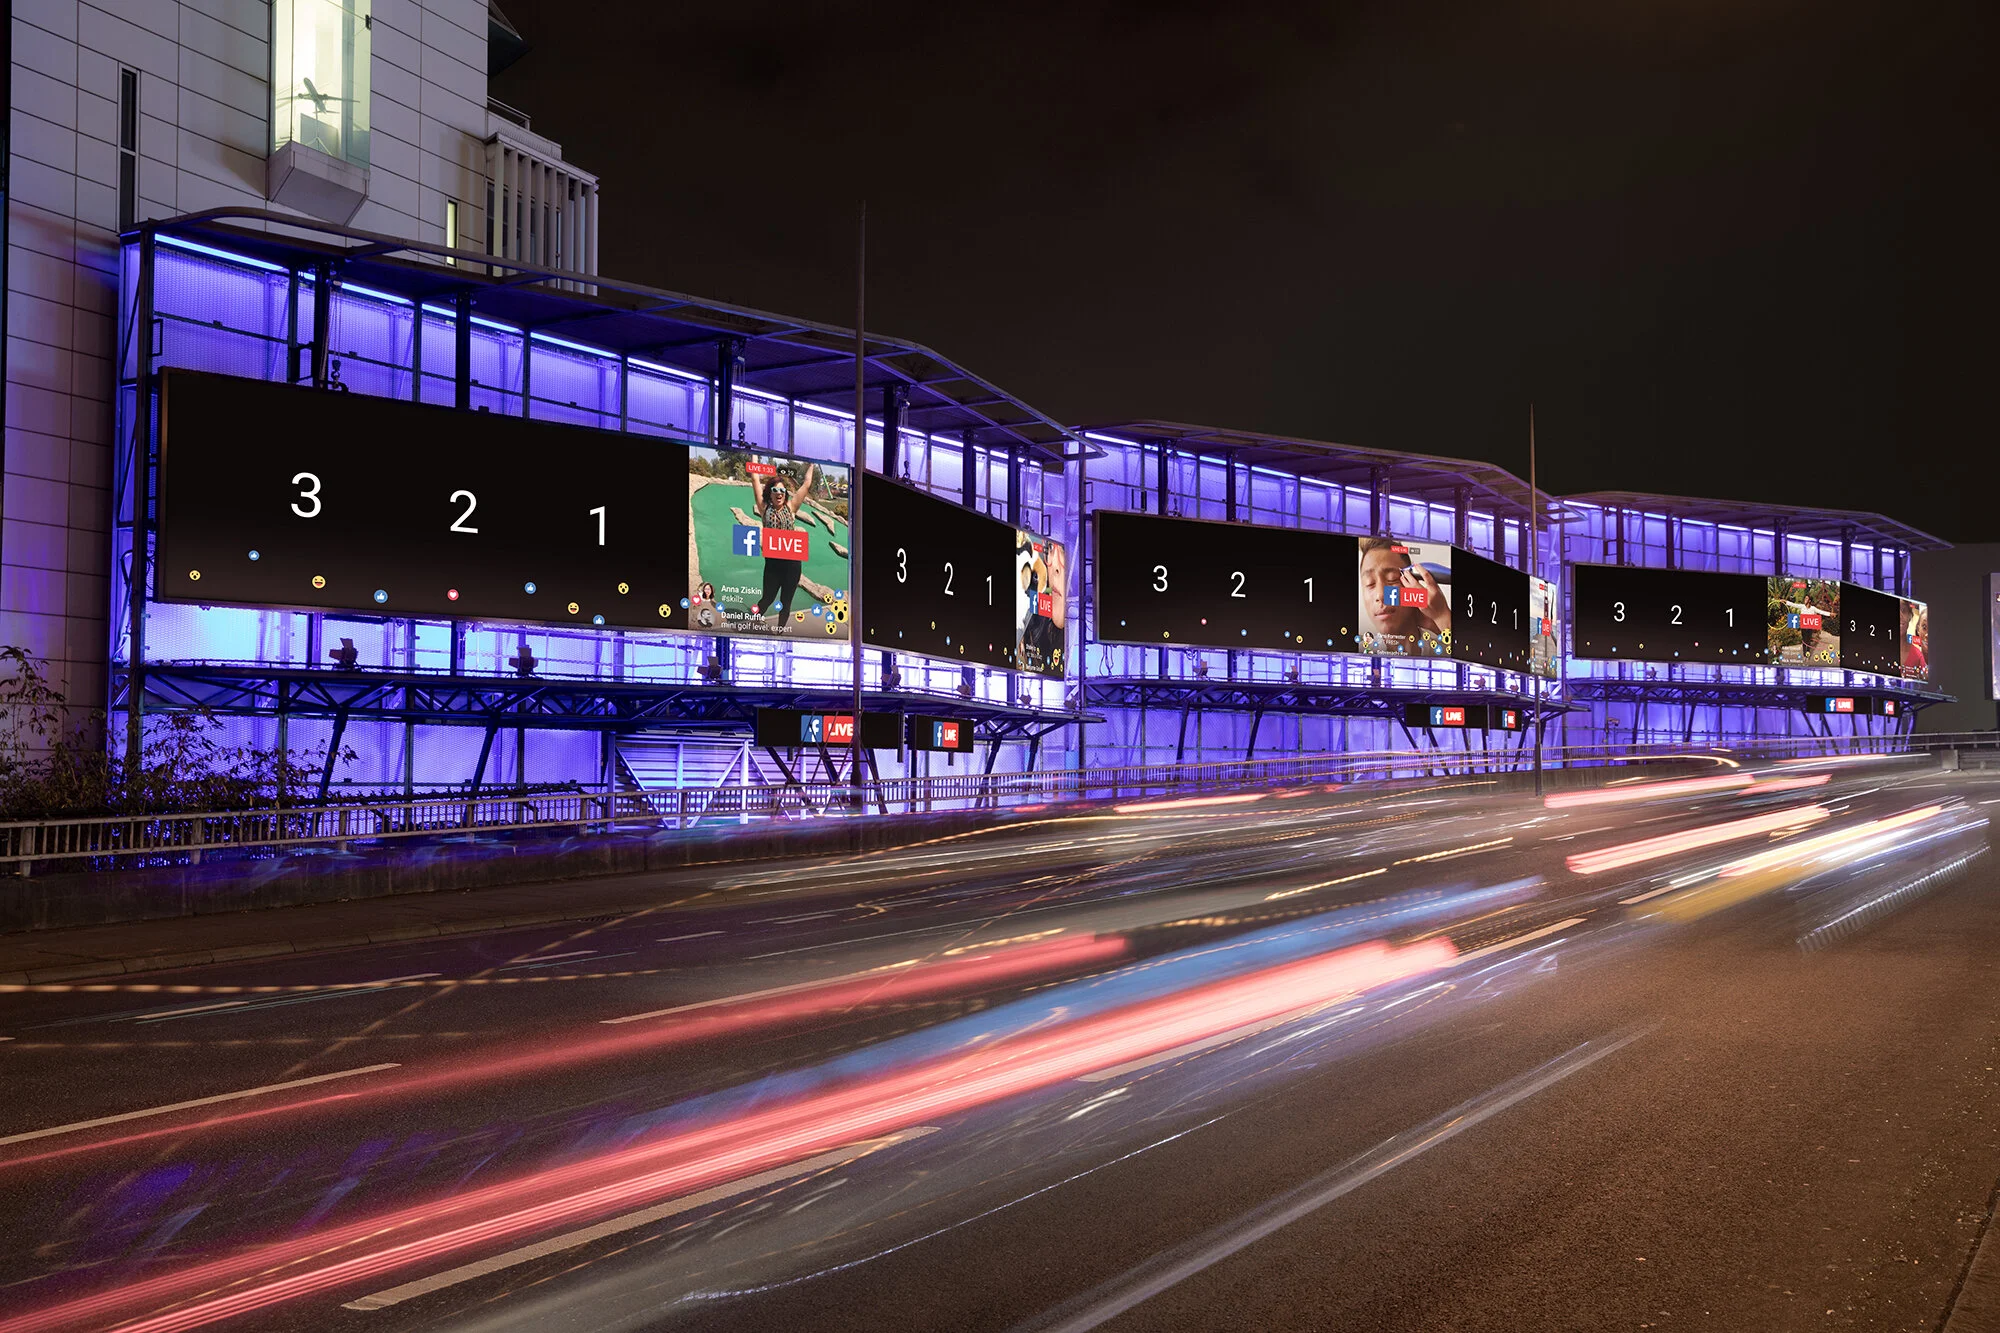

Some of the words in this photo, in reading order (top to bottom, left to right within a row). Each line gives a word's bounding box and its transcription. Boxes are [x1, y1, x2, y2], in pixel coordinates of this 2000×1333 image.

[748, 464, 761, 472] LIVE
[290, 472, 322, 518] 3
[449, 489, 479, 534] 2
[589, 505, 606, 546] 1
[743, 530, 757, 556] f
[769, 536, 802, 553] LIVE
[896, 547, 907, 585] 3
[944, 562, 954, 597] 2
[985, 574, 993, 606] 1
[1152, 564, 1168, 593] 3
[1230, 571, 1246, 598] 2
[1303, 577, 1313, 603] 1
[721, 585, 739, 593] Anna
[741, 586, 762, 595] Ziskin
[721, 594, 744, 603] #skillz
[1390, 588, 1397, 606] f
[1403, 592, 1424, 603] LIVE
[1032, 594, 1038, 614] f
[1040, 599, 1051, 612] LIVE
[1467, 593, 1474, 618] 3
[1491, 601, 1498, 625] 2
[1512, 608, 1518, 630] 1
[721, 611, 743, 620] Daniel
[744, 613, 766, 622] Ruffle
[1613, 601, 1626, 622] 3
[1670, 604, 1683, 625] 2
[1725, 608, 1733, 628] 1
[1792, 615, 1798, 628] f
[1802, 618, 1819, 627] LIVE
[737, 622, 751, 631] golf
[752, 623, 769, 631] level:
[771, 625, 792, 633] expert
[1850, 619, 1857, 632] 3
[1869, 624, 1876, 637] 2
[1887, 629, 1893, 640] 1
[1829, 699, 1835, 712] f
[1435, 709, 1442, 725] f
[1445, 711, 1462, 721] LIVE
[809, 719, 820, 742] f
[828, 723, 853, 736] LIVE
[937, 725, 942, 747] f
[945, 728, 956, 741] LIVE
